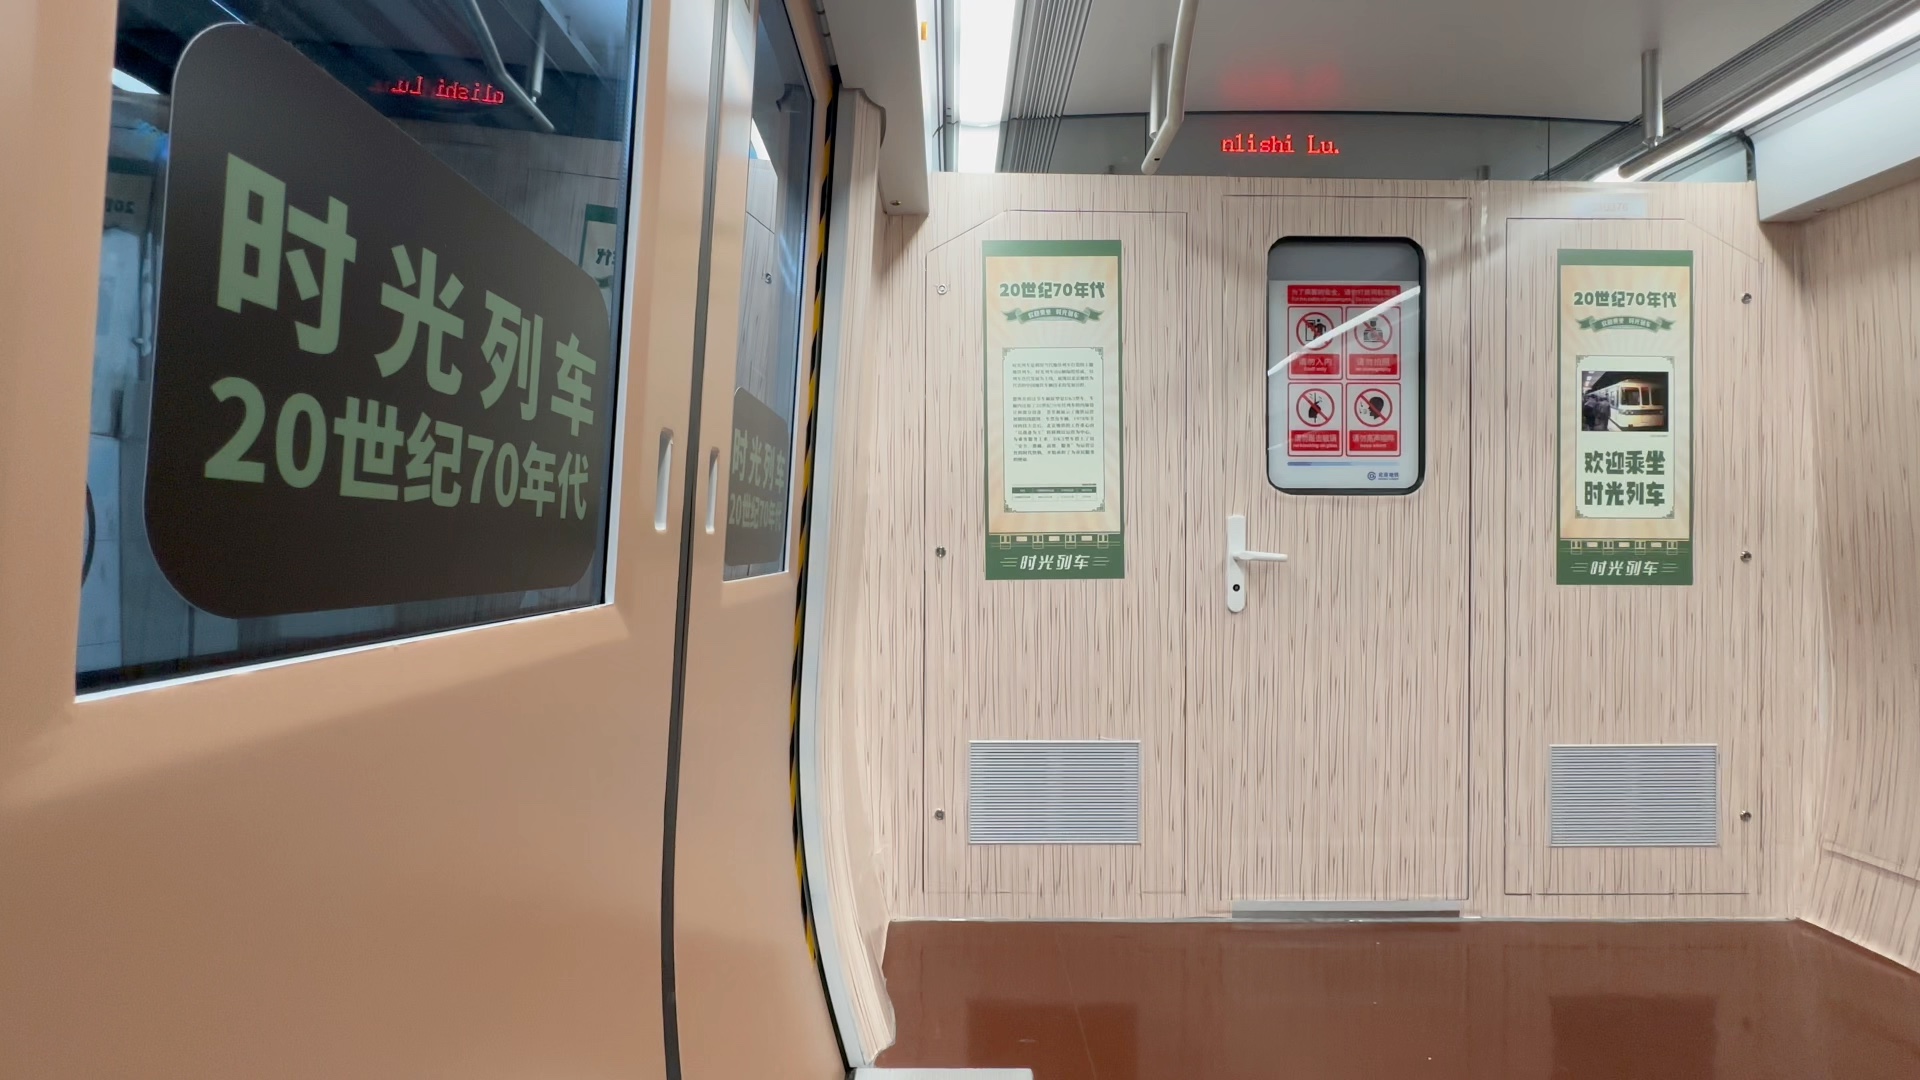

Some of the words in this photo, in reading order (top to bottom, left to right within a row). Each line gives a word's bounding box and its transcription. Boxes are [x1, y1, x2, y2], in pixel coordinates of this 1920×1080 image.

[1222, 133, 1295, 153] nlishi
[1307, 134, 1339, 154] Lu.
[217, 153, 597, 437] 时光列车
[999, 281, 1105, 299] 20世纪70年代
[1573, 290, 1677, 308] 20世纪70年代
[204, 376, 589, 520] 20世纪70年代
[732, 428, 786, 494] 时光列车
[1584, 450, 1666, 475] 欢迎乘坐
[1584, 481, 1665, 506] 时光列车
[729, 494, 782, 532] 20世纪70年代
[1019, 554, 1090, 571] 时光列车
[1590, 560, 1660, 576] 时光列车
